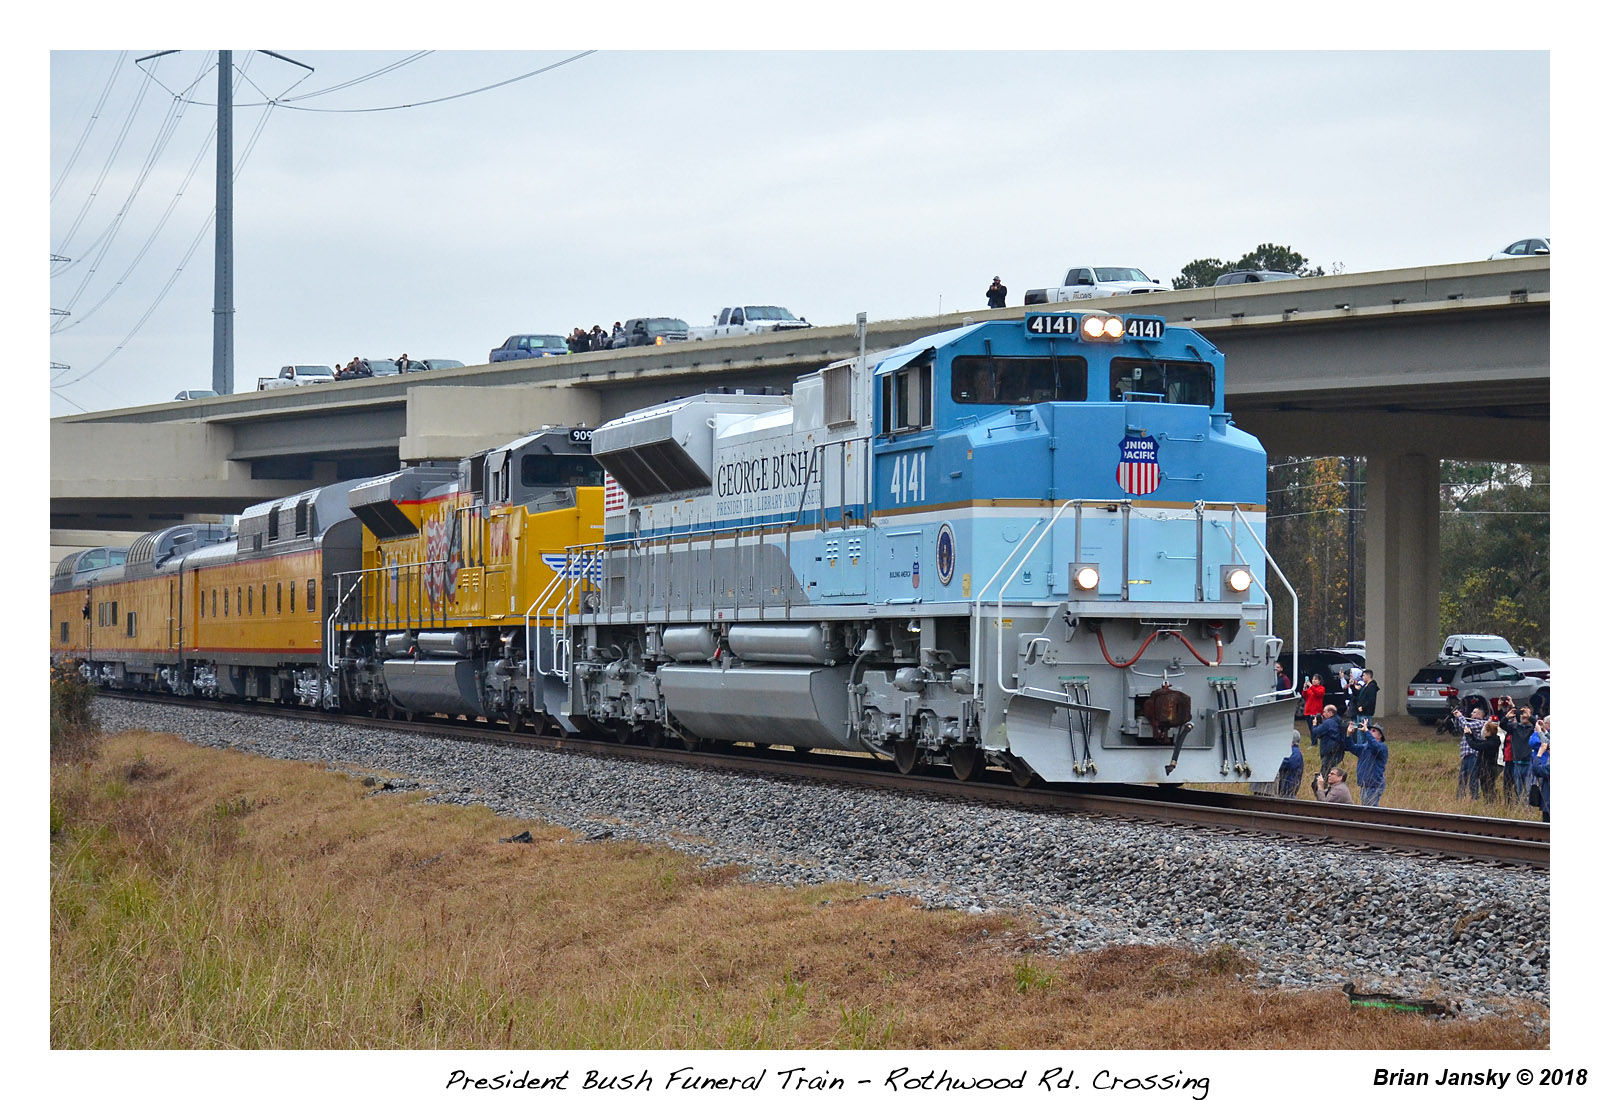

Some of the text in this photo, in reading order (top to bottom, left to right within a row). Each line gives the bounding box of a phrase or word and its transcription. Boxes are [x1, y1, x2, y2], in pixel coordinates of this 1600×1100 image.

[1032, 316, 1073, 334] 4141
[1128, 320, 1161, 338] 4141
[573, 430, 592, 441] 909
[717, 457, 769, 498] GEORGE
[772, 450, 809, 490] BUSH
[890, 451, 926, 504] 4141
[716, 498, 756, 517] PRESIDENTIA
[757, 493, 782, 511] LIBRARY
[783, 491, 796, 508] AND
